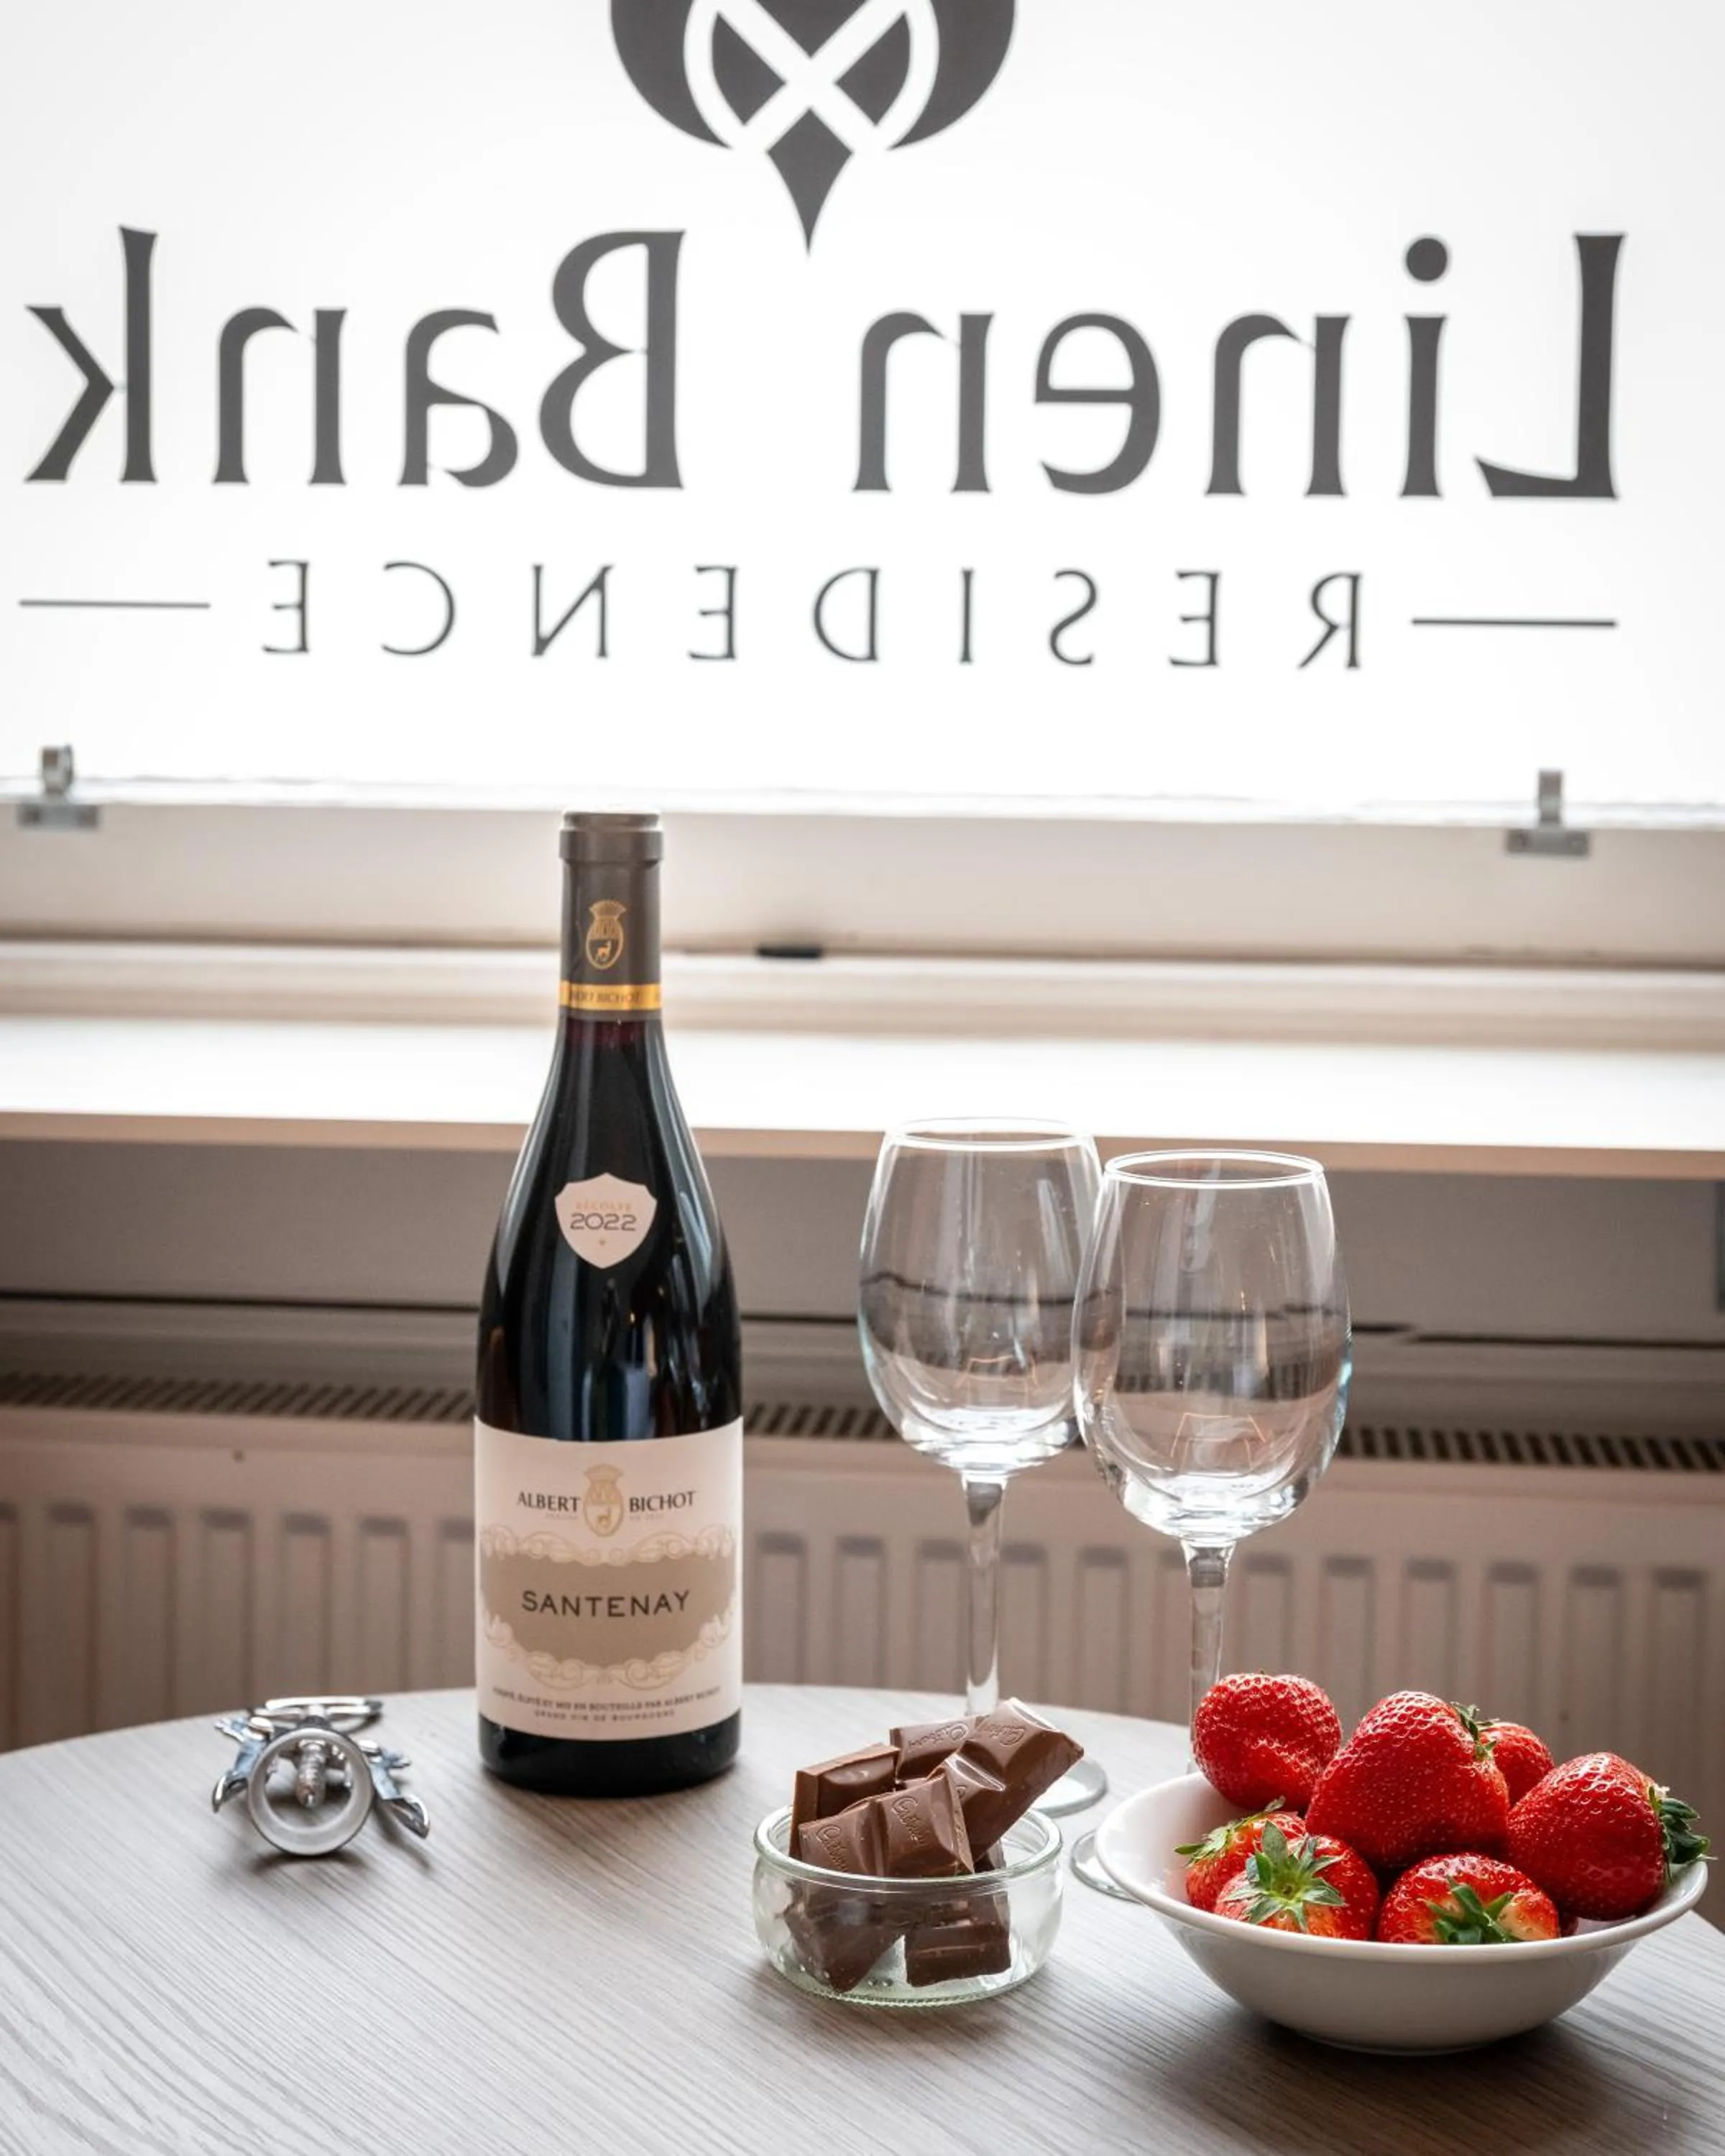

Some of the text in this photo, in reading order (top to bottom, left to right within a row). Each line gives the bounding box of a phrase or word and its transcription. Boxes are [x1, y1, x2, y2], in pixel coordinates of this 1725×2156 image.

[570, 1212, 637, 1232] 2022
[518, 1490, 697, 1513] ALBERT BICHOT
[521, 1590, 690, 1618] SANTENAY
